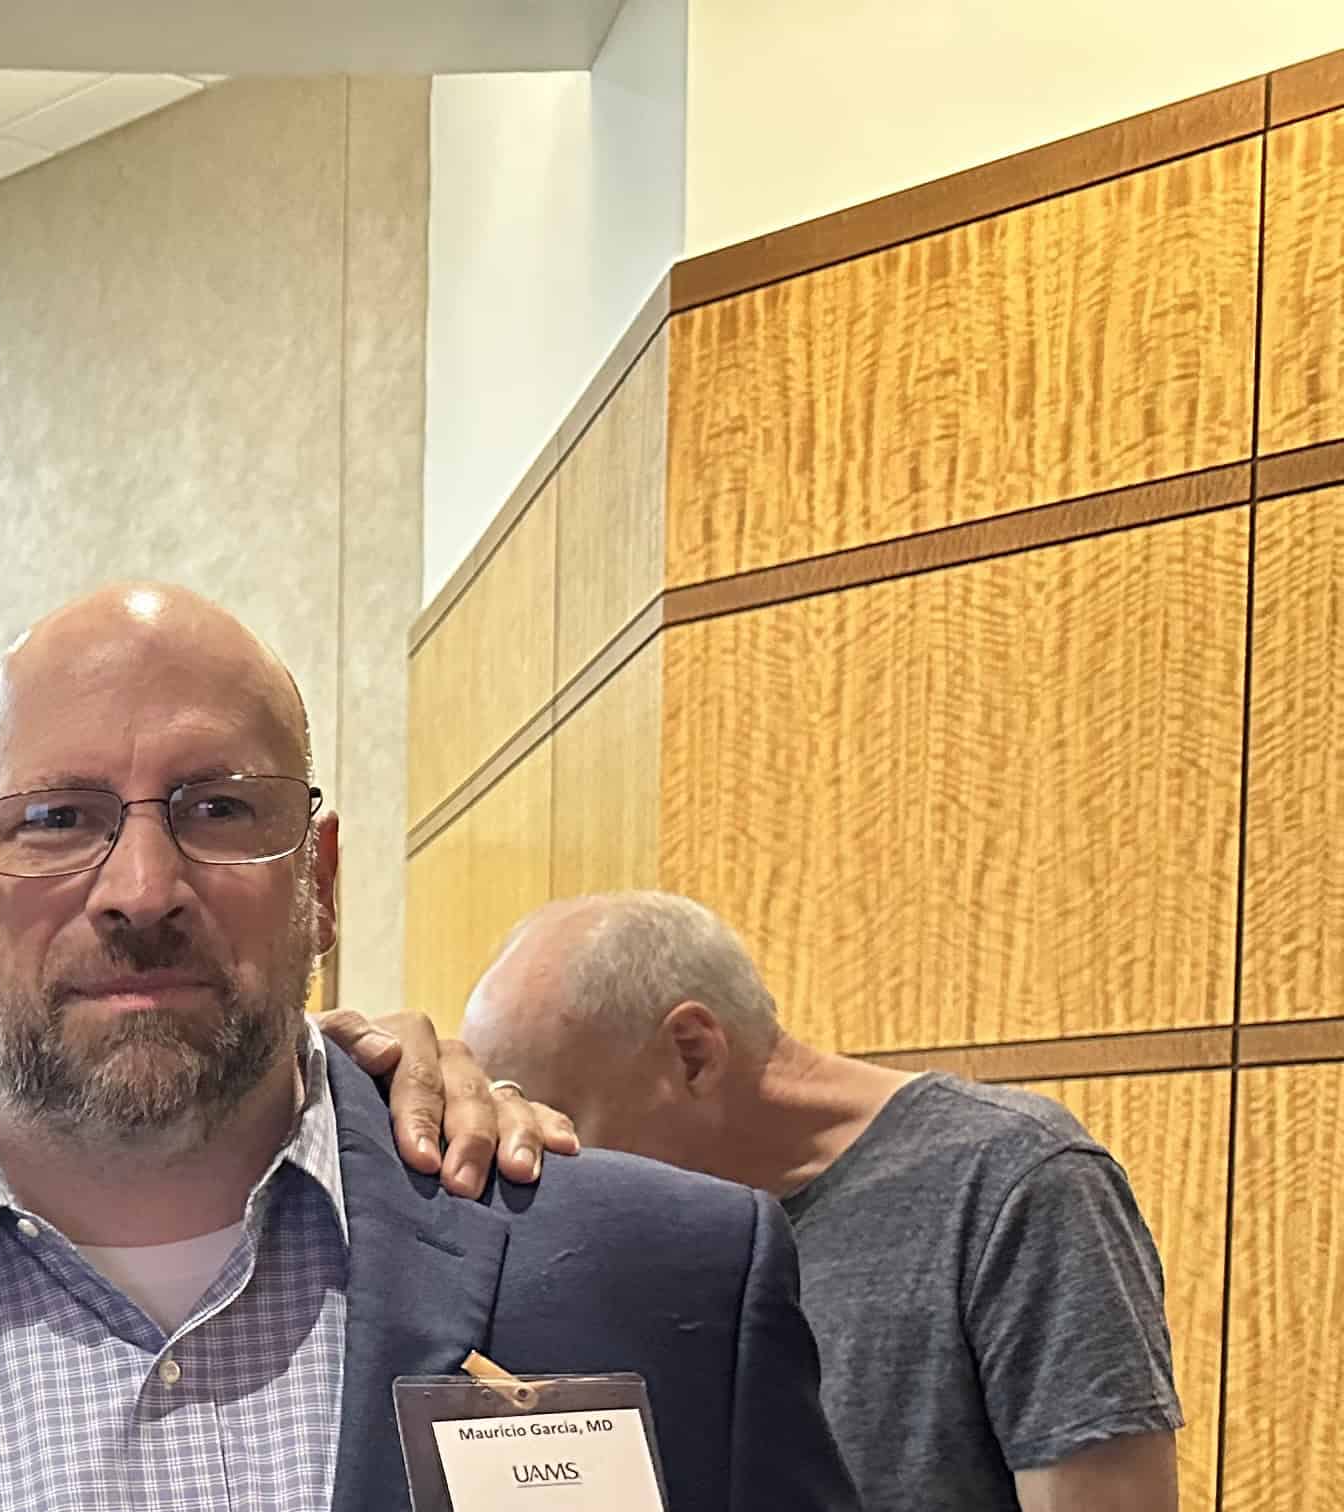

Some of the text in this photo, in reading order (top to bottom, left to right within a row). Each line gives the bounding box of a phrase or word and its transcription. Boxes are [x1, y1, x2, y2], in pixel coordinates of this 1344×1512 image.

[458, 1424, 527, 1441] Mauricio
[586, 1419, 613, 1433] MD
[512, 1462, 580, 1484] UAMS
